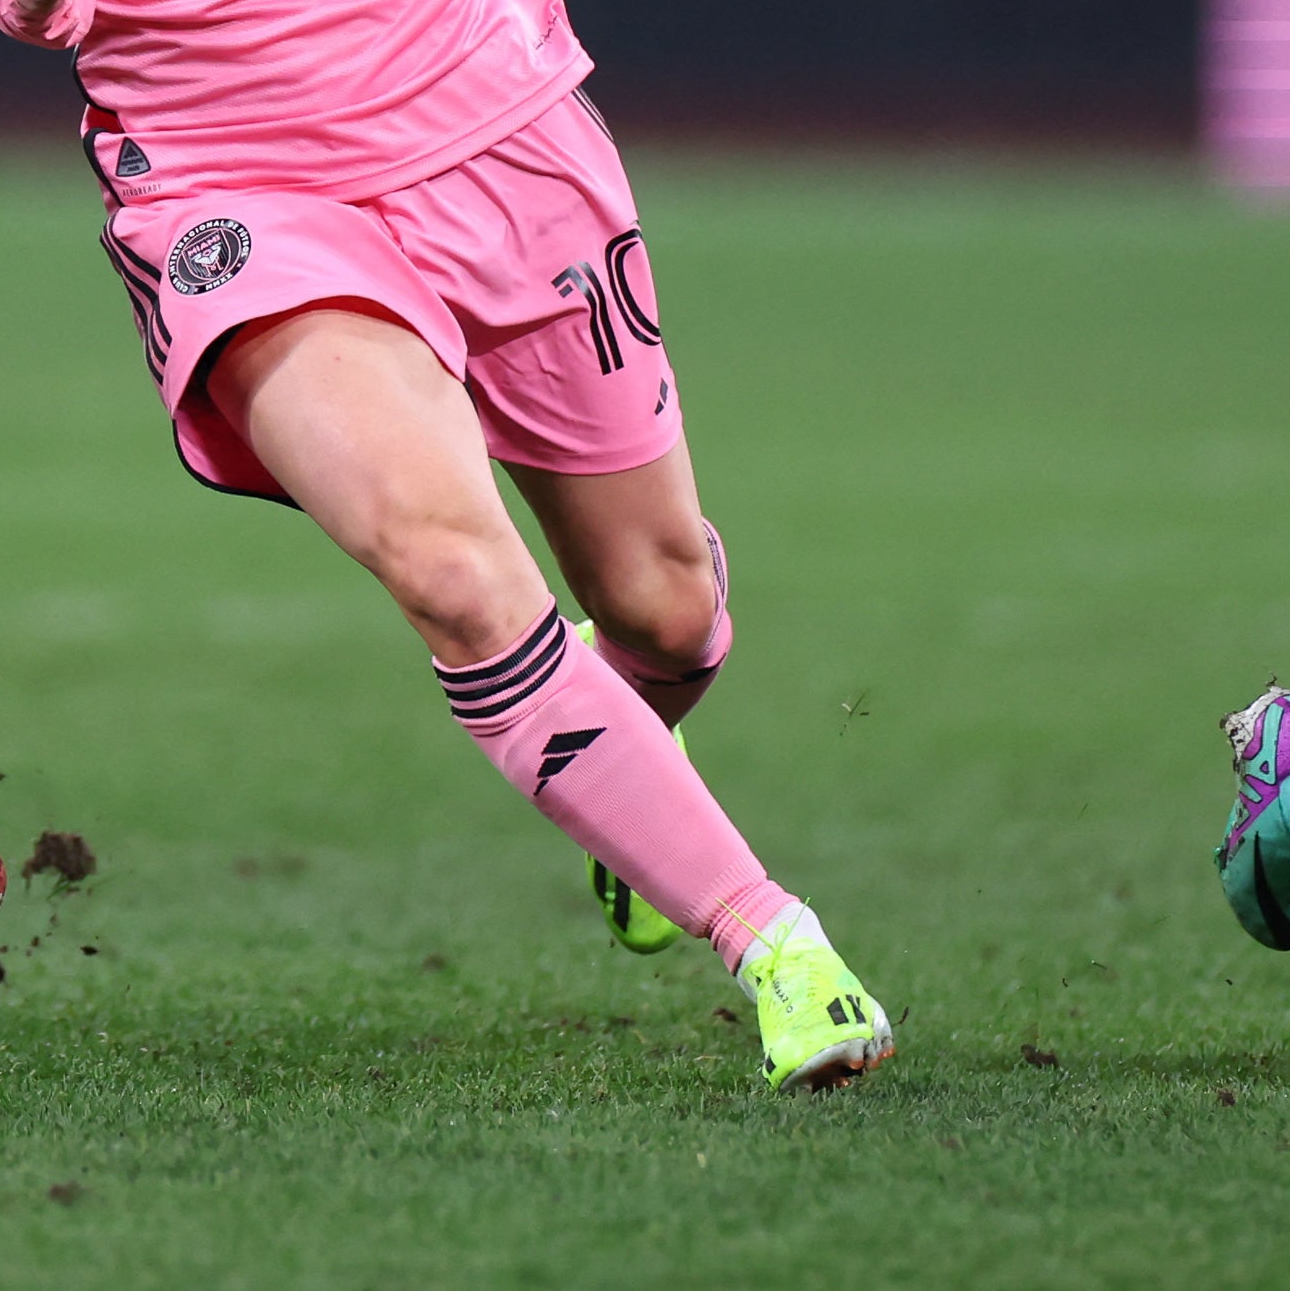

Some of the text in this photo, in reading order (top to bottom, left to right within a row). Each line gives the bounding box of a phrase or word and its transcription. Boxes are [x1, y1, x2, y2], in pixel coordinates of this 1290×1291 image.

[169, 220, 225, 277] INTERNACIONAL
[187, 234, 221, 257] MIAMI
[172, 277, 189, 293] CLUB
[551, 228, 662, 376] 10
